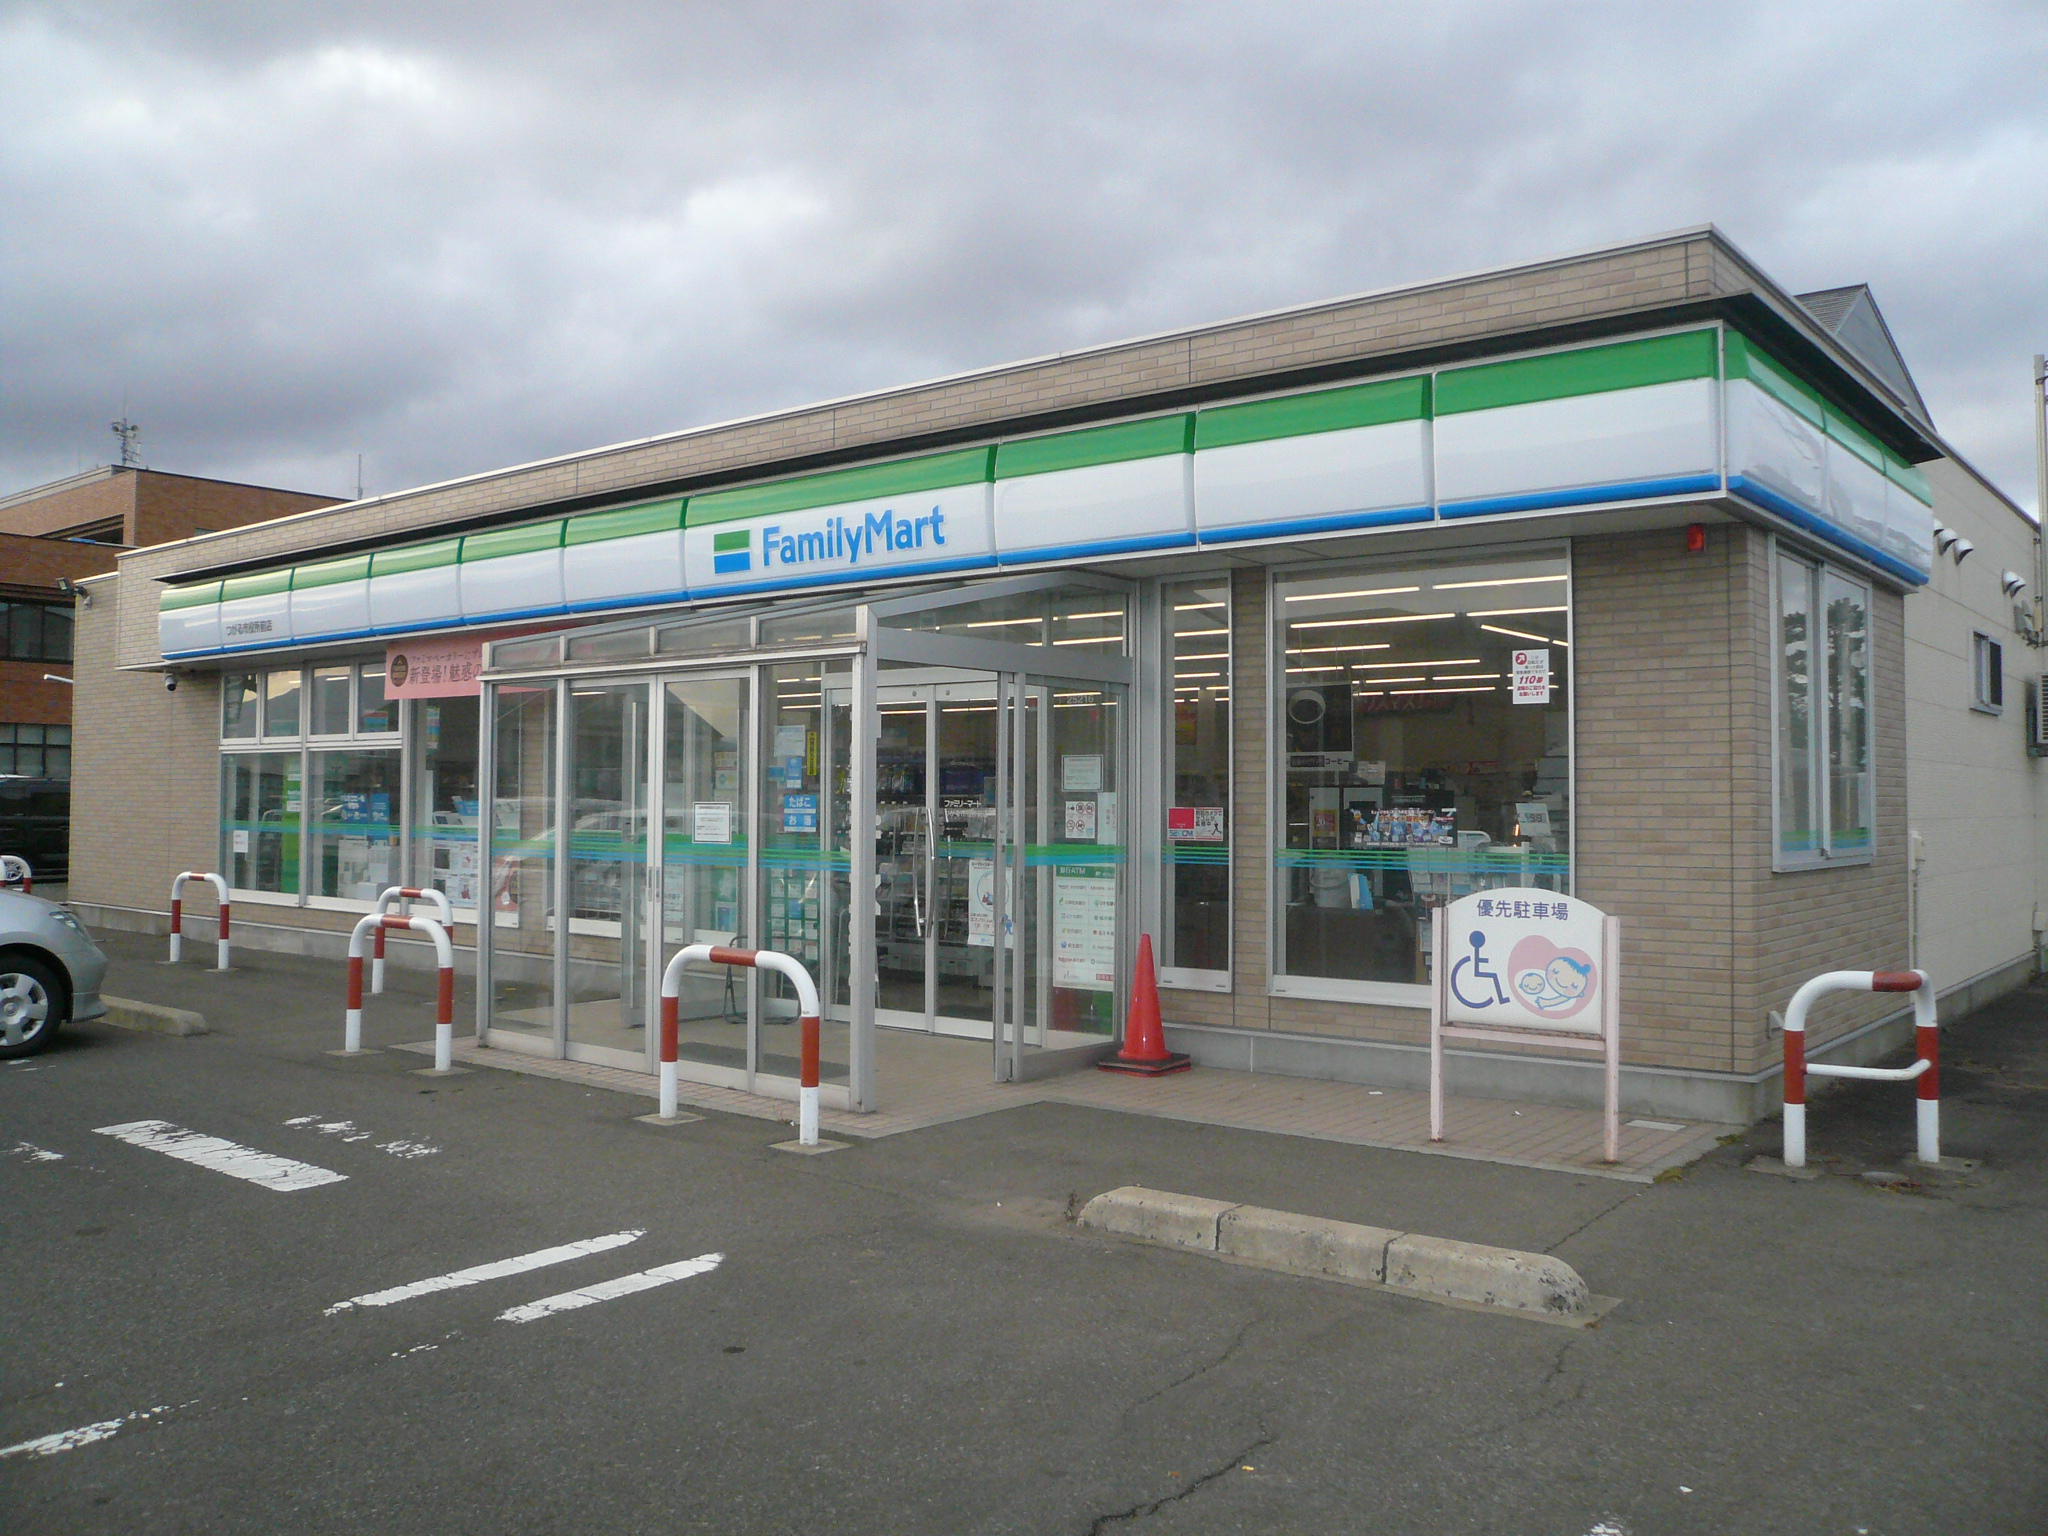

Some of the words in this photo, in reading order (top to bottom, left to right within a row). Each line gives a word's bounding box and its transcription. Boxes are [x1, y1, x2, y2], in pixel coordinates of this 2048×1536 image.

[763, 505, 946, 567] FamilyMart
[788, 797, 811, 808] たばこ
[1477, 899, 1569, 921] 優先駐車場
